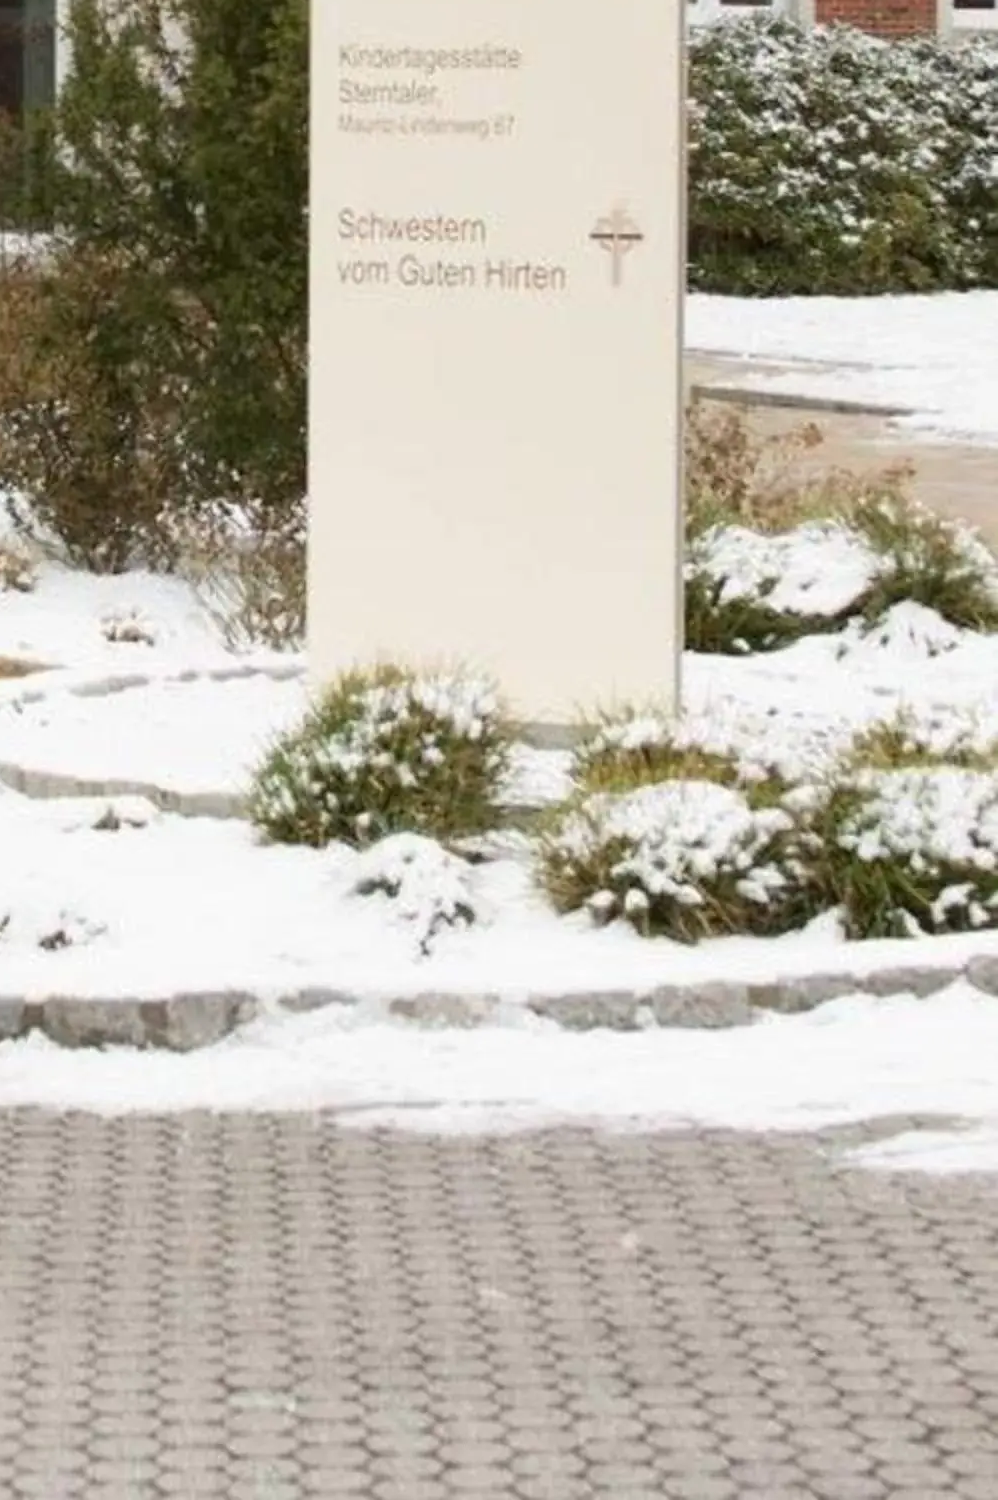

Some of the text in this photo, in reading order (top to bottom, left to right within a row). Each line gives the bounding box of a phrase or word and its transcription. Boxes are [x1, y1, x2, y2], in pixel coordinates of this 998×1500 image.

[338, 207, 486, 243] Schwestern
[337, 255, 566, 290] vom Guten Hirten
